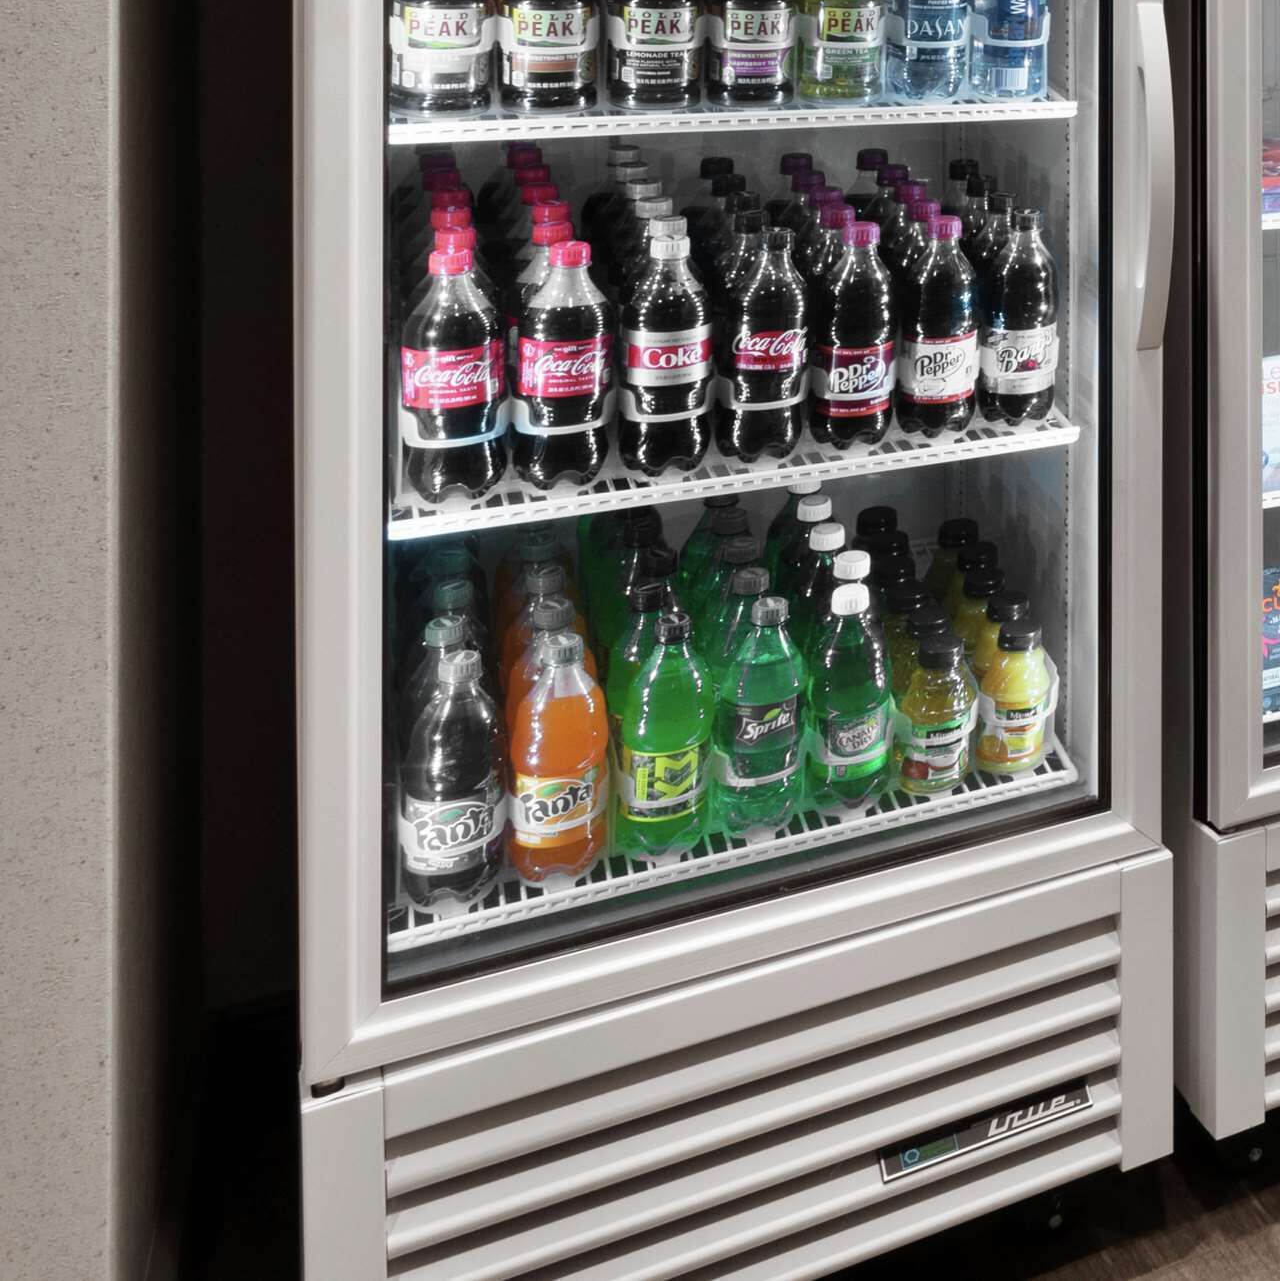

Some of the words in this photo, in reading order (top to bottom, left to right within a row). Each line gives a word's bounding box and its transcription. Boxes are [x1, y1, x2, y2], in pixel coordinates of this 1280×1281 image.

[409, 20, 468, 37] PEAK
[517, 21, 574, 37] PEAK
[627, 19, 681, 35] PEAK
[731, 20, 780, 36] PEAK
[828, 17, 874, 33] PEAK
[732, 327, 808, 357] Coca-Cola
[534, 348, 606, 376] Coca-Cola
[643, 345, 704, 368] Coke
[914, 354, 963, 376] Pepper
[932, 350, 952, 364] Dr
[414, 358, 492, 387] Coca-Cola
[830, 366, 882, 393] Pepper
[848, 362, 870, 381] Dr
[742, 710, 791, 741] Sprite
[852, 734, 874, 750] DRY
[520, 782, 593, 824] Fanta
[413, 804, 495, 851] Fanta
